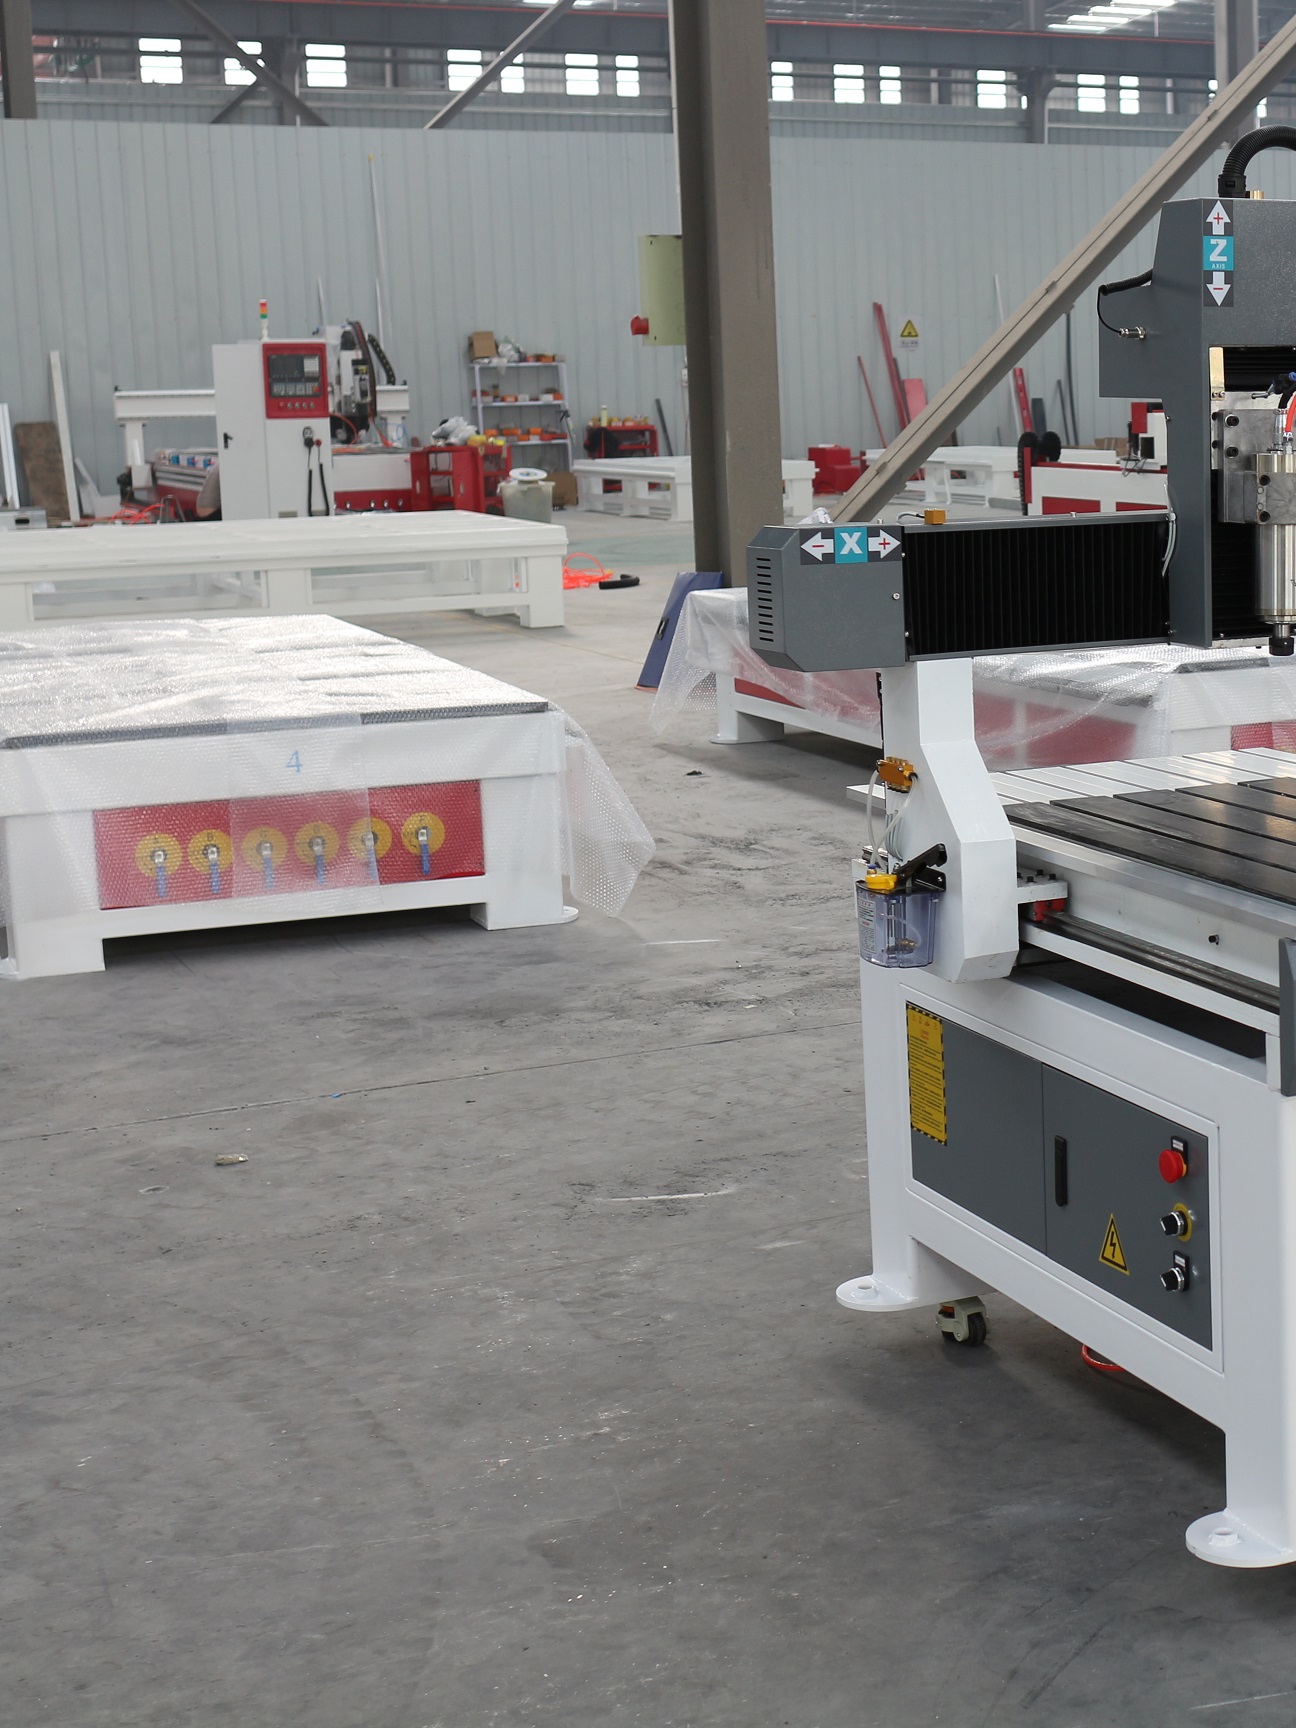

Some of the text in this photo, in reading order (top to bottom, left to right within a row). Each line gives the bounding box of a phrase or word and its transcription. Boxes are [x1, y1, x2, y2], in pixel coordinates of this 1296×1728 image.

[1209, 238, 1228, 262] Z
[840, 532, 863, 555] X
[286, 750, 303, 773] 4
